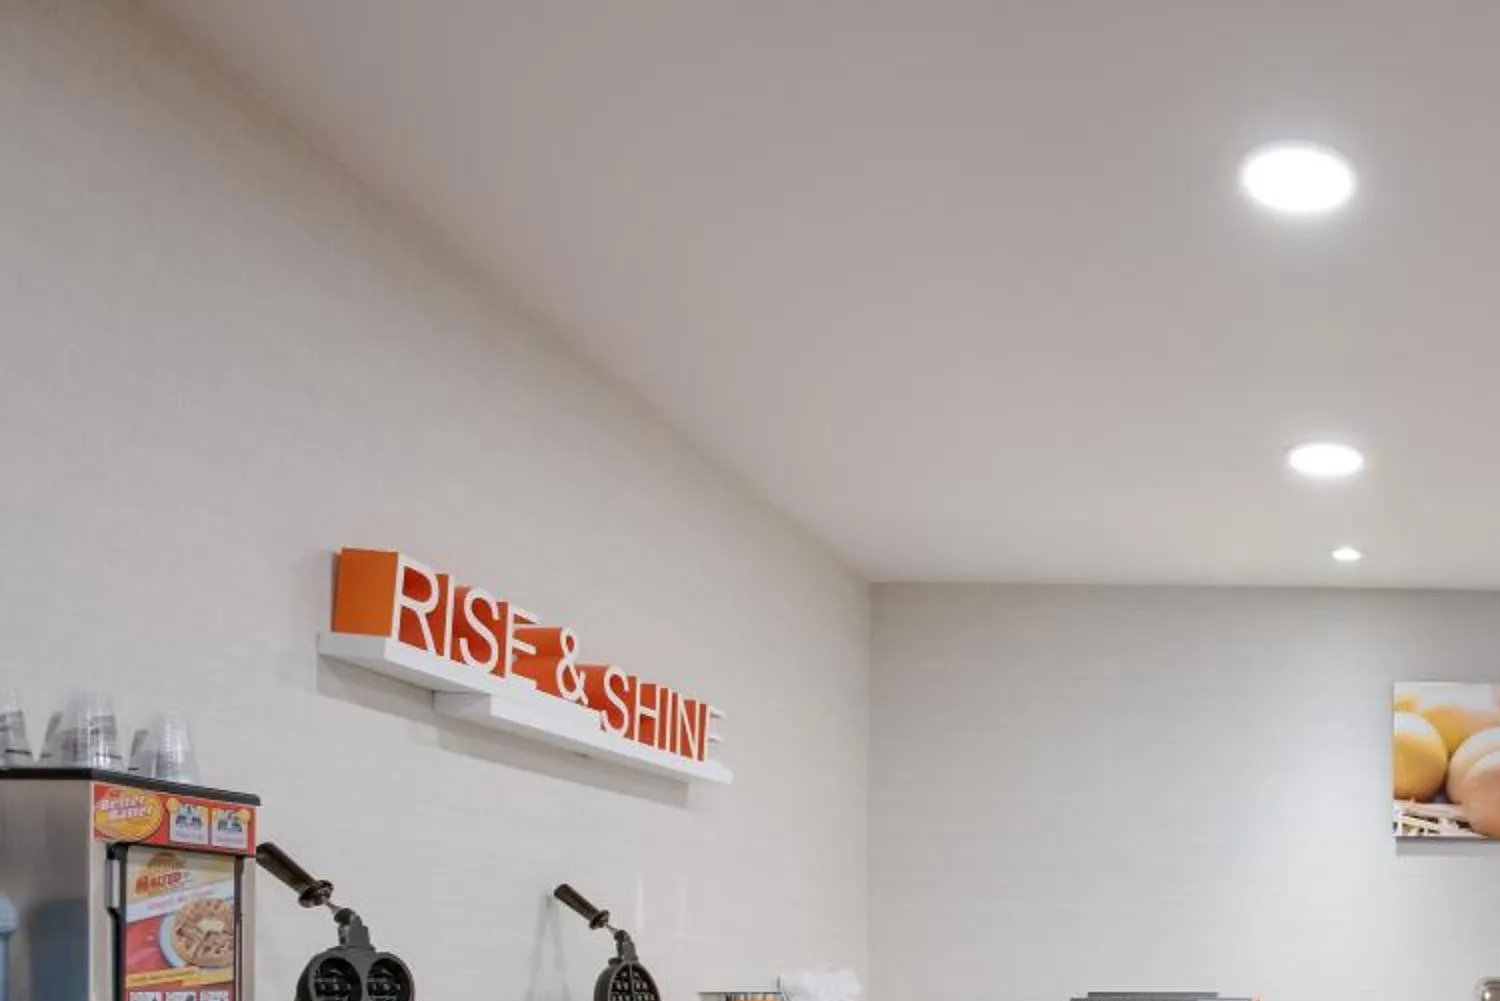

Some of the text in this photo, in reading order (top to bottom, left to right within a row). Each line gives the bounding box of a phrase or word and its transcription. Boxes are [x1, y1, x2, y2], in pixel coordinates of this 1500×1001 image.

[390, 553, 726, 763] RISE & SHINE
